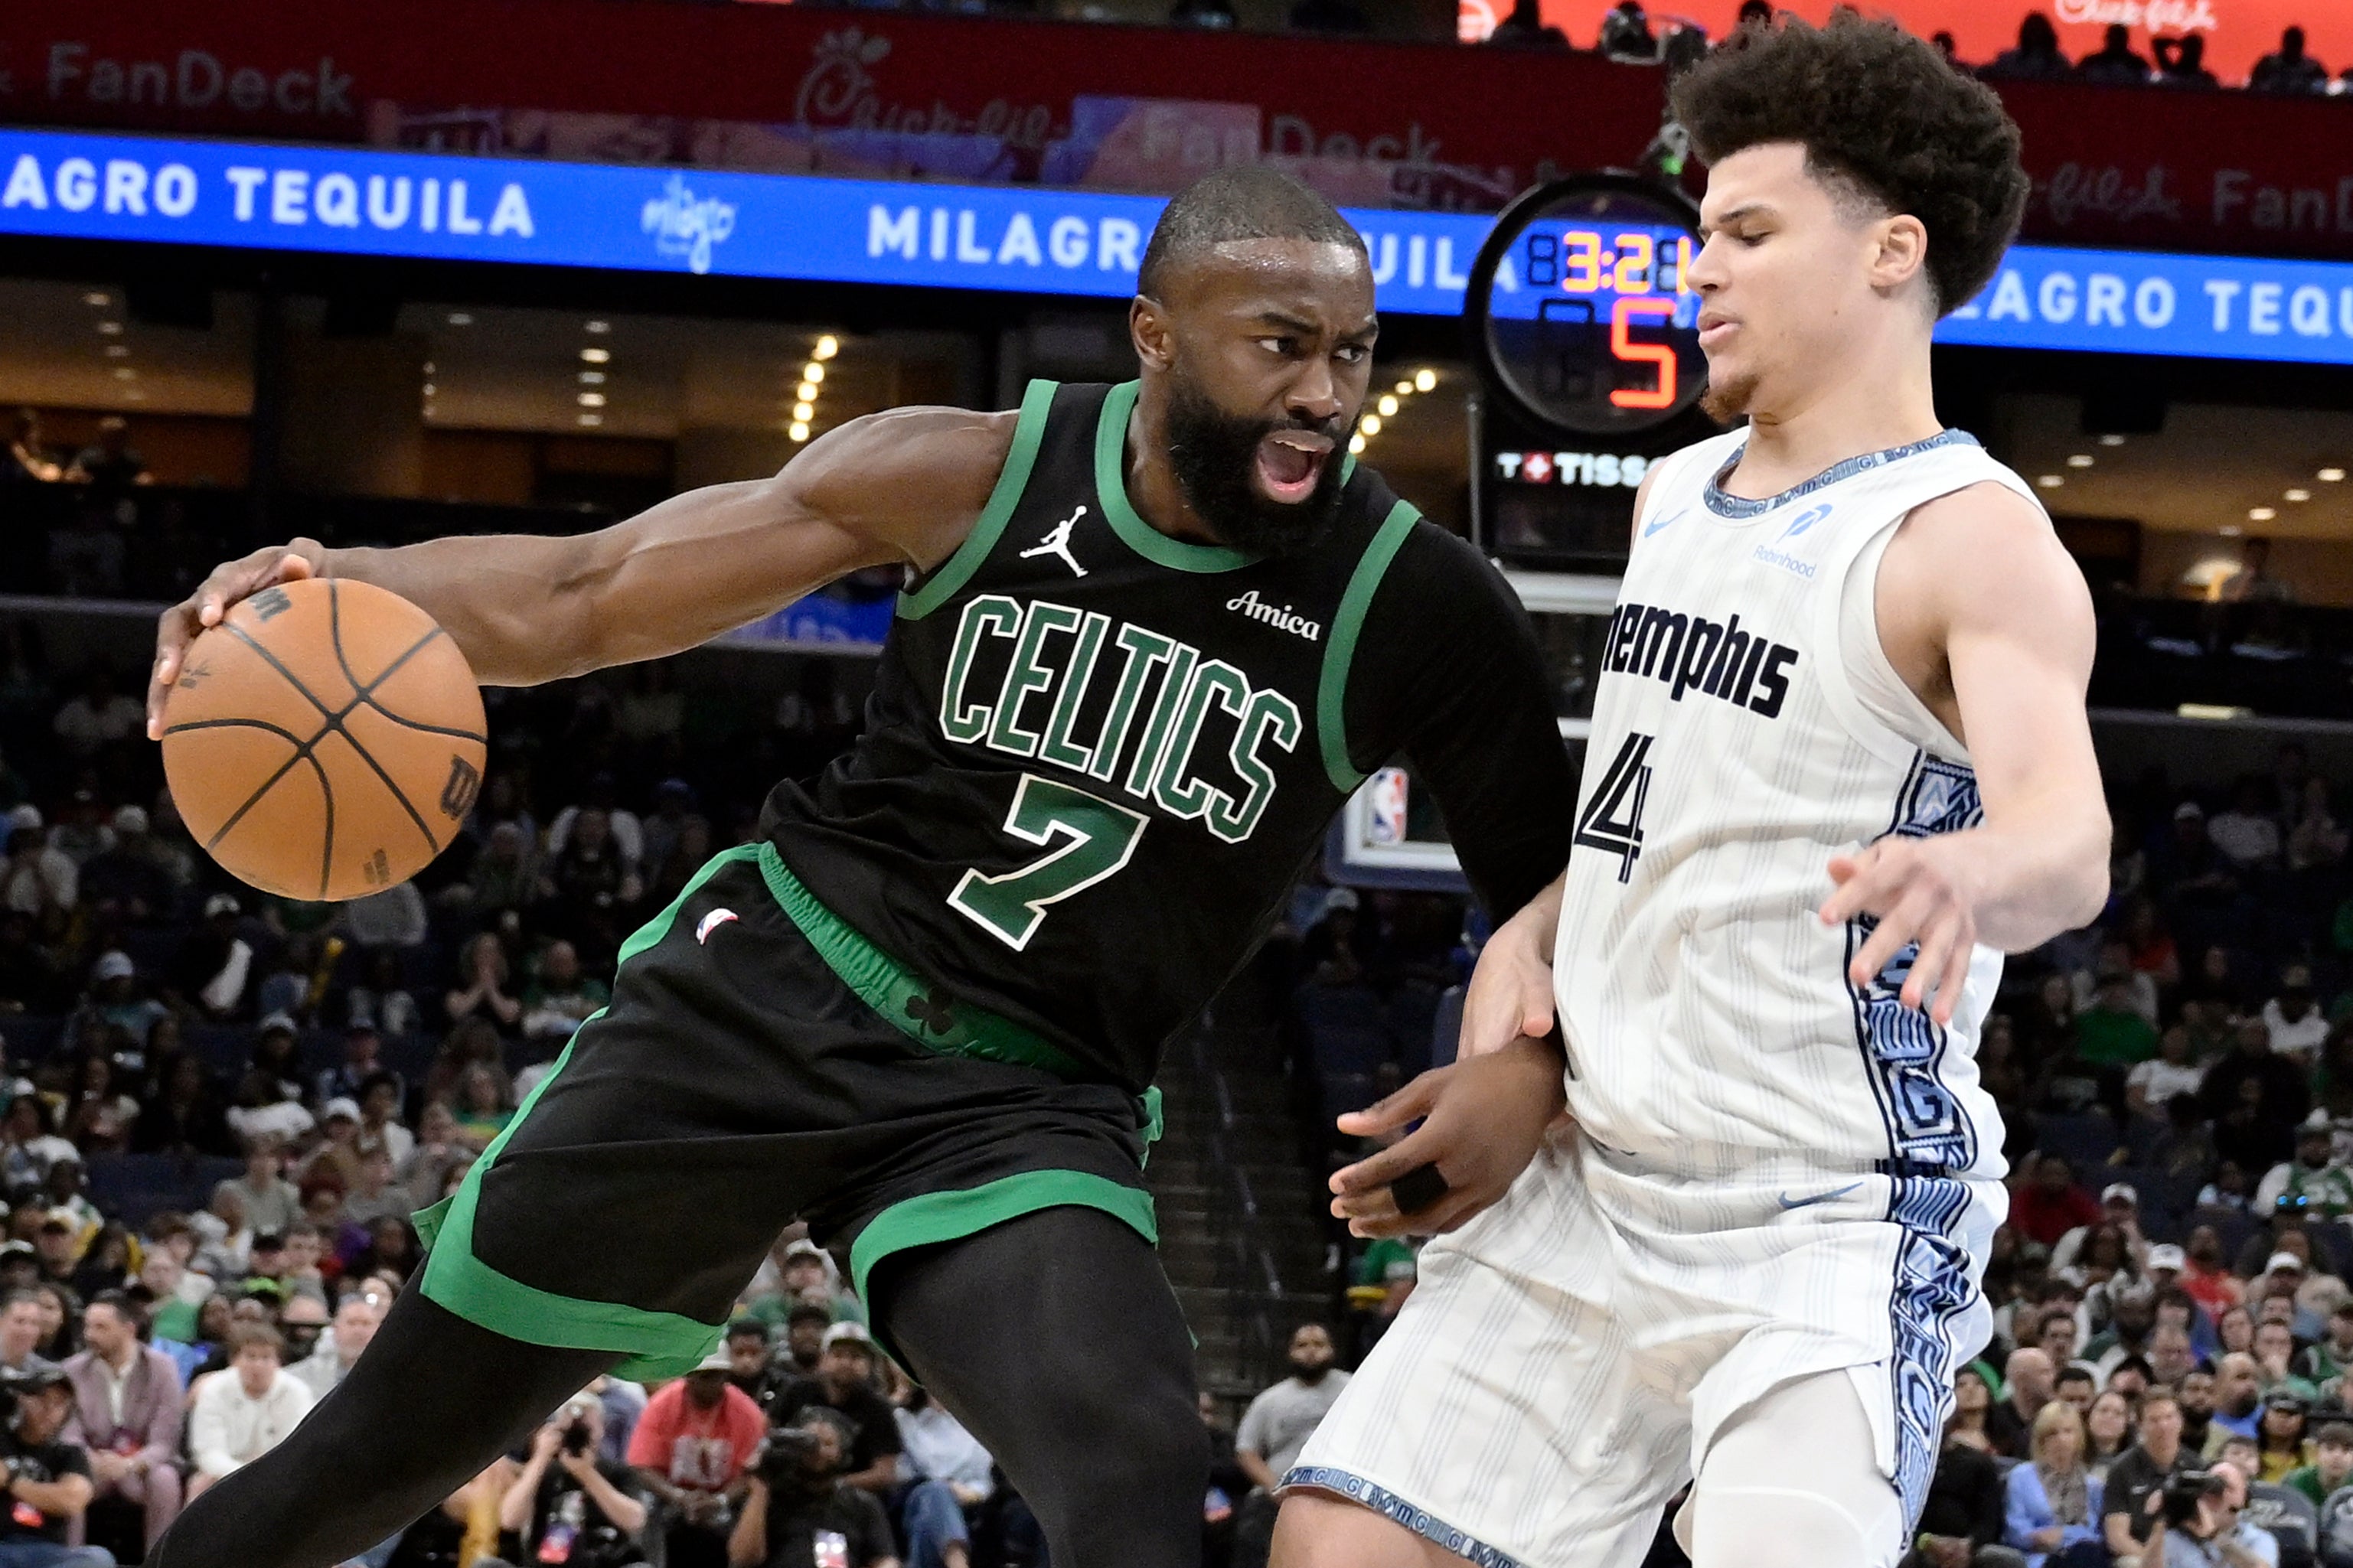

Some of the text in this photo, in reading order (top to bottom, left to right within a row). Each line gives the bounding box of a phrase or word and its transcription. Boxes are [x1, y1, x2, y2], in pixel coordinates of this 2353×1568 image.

[47, 41, 357, 117] FanDeck
[2, 153, 534, 238] AGRO TEQUILA
[866, 204, 1150, 272] MILAGR
[1609, 295, 1678, 410] 5
[1553, 451, 1666, 488] TISS
[1752, 544, 1818, 579] Robinhood
[1225, 590, 1321, 641] Amica
[938, 593, 1304, 844] CELTICS
[1573, 731, 1656, 885] 4
[946, 771, 1151, 952] 7
